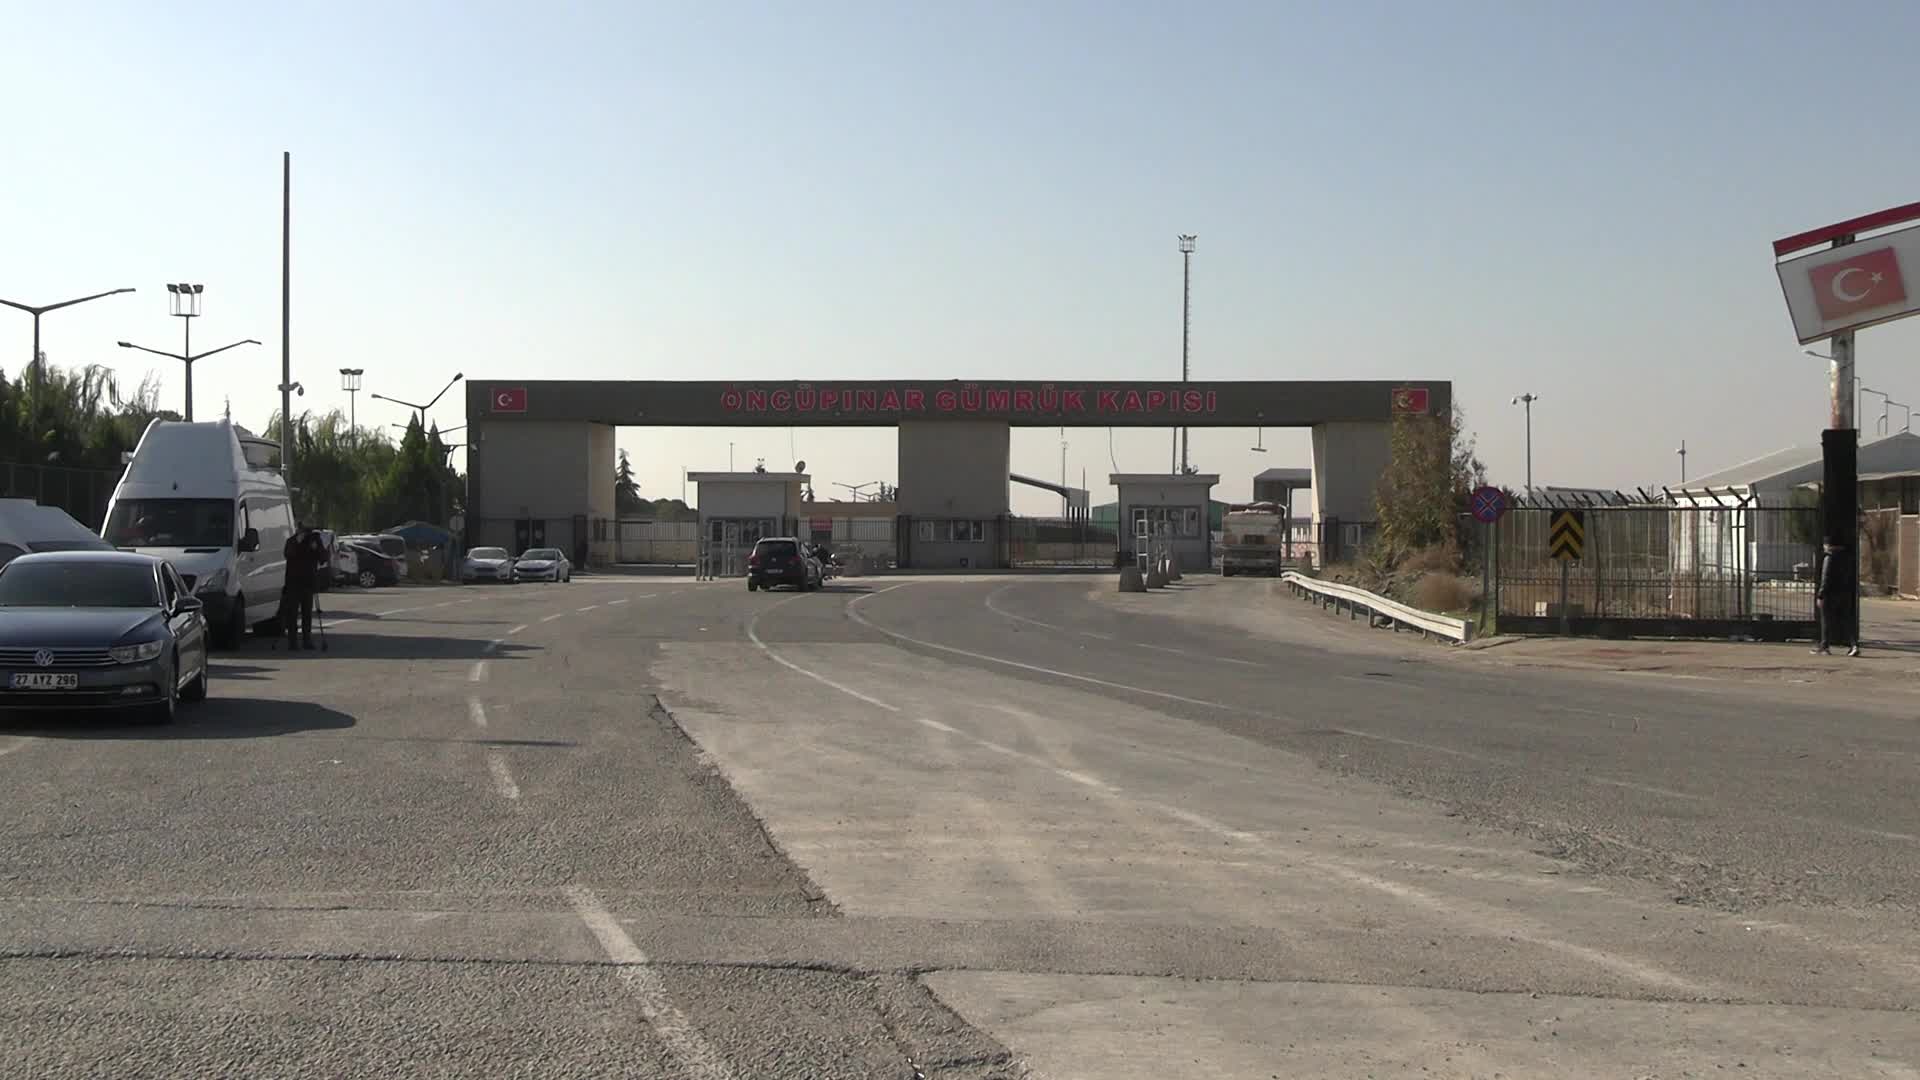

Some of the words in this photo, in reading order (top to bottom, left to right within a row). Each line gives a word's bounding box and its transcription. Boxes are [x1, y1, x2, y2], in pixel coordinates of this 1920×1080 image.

[720, 384, 926, 411] ÖNCÜPINAR
[935, 384, 1086, 411] GÜMRÜK
[1097, 390, 1217, 411] KAPISI
[16, 674, 28, 686] 27
[33, 674, 52, 686] AYZ
[57, 674, 76, 686] 296
